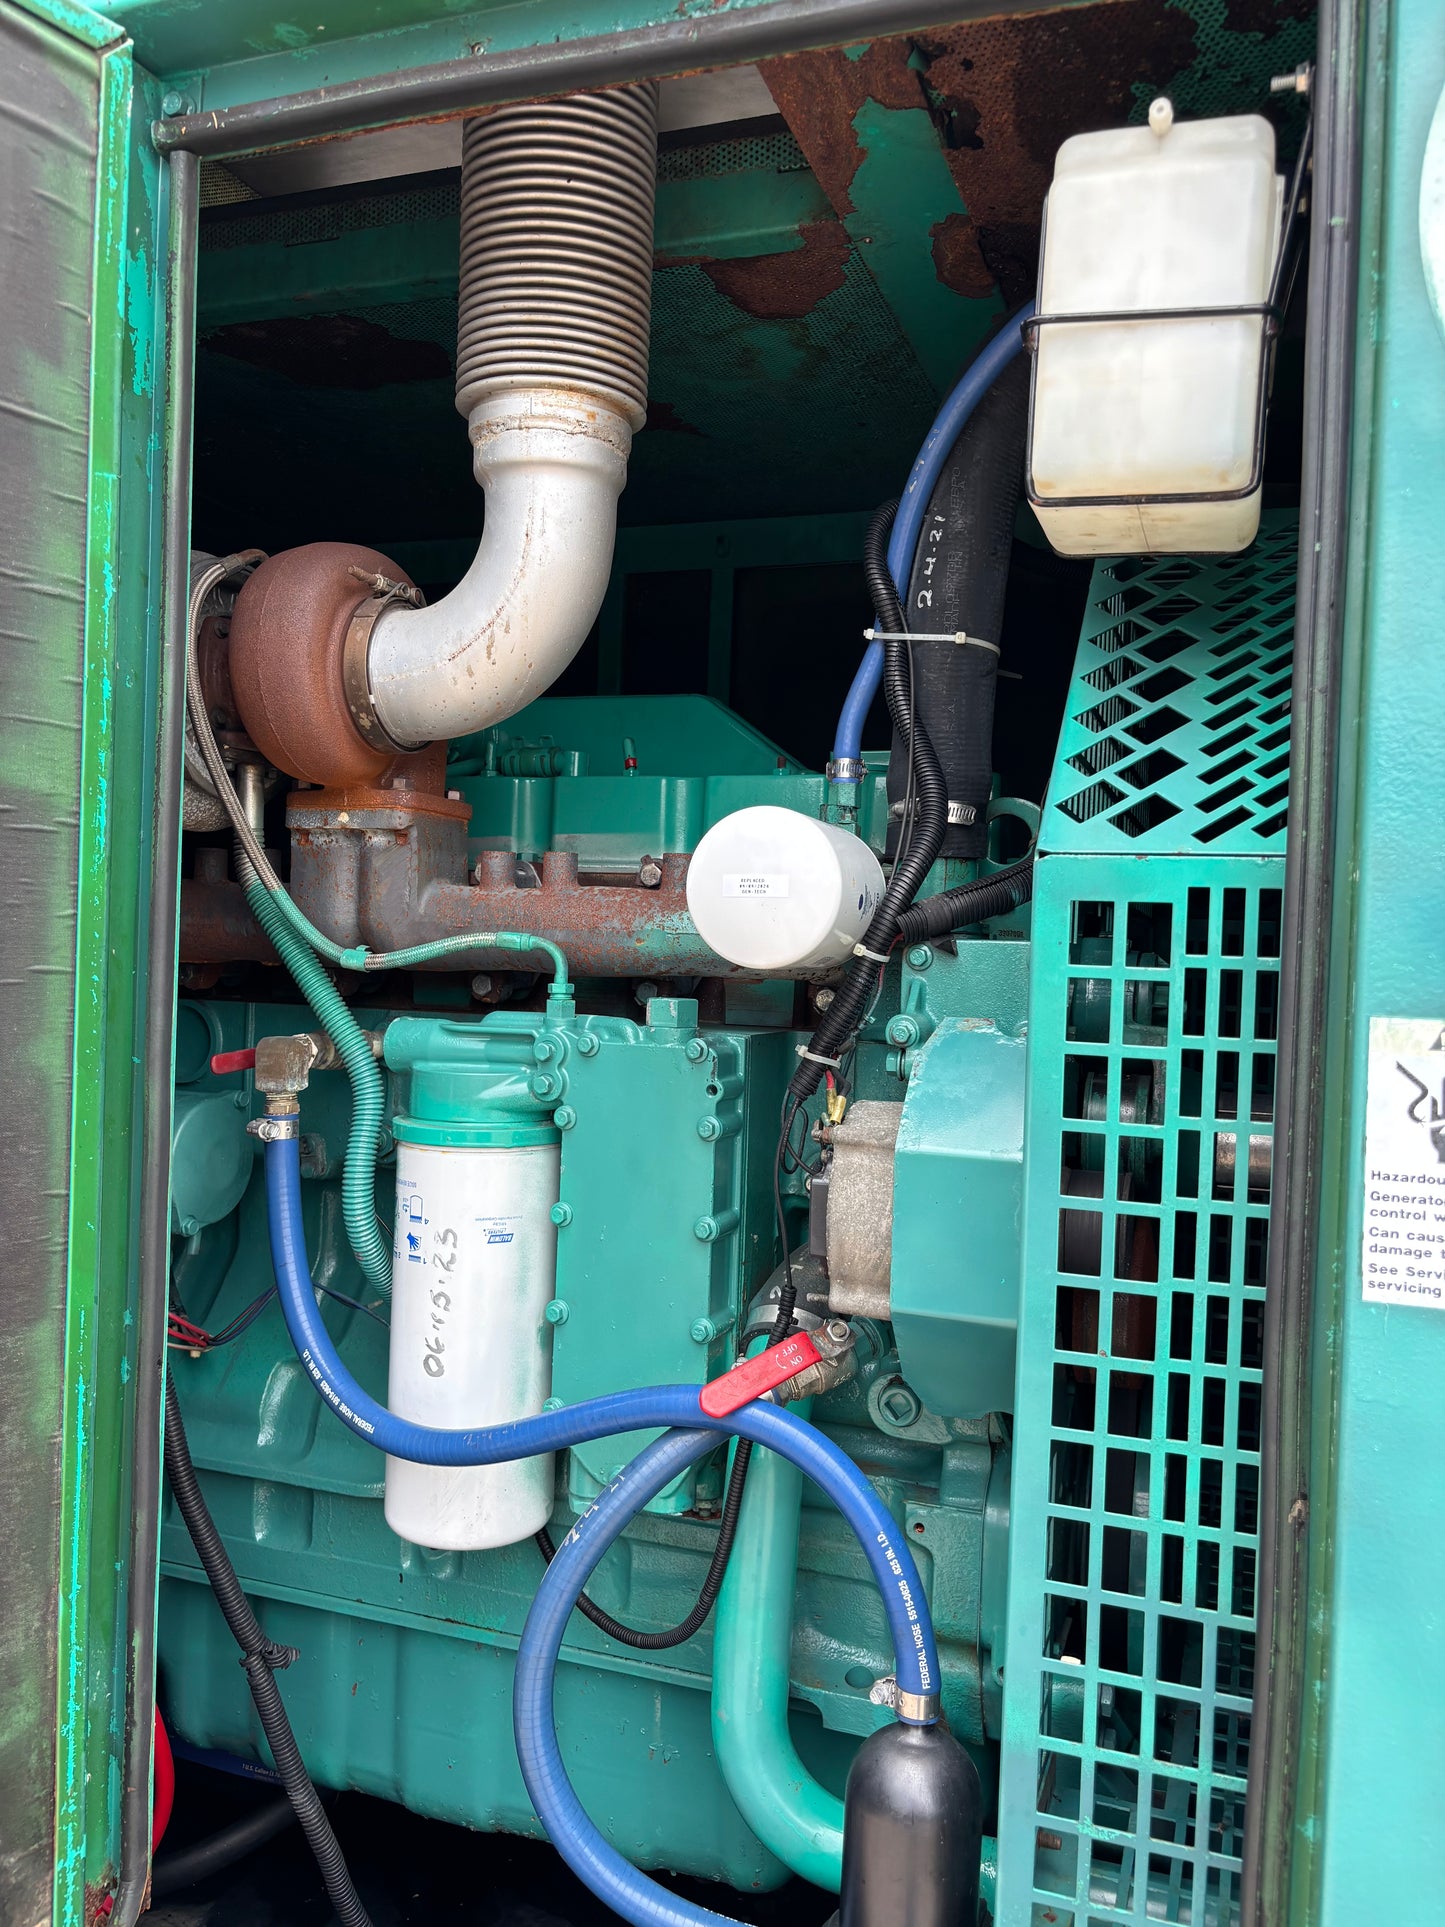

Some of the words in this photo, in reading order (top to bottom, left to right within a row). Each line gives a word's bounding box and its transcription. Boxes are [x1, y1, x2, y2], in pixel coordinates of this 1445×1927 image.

[1370, 1190, 1445, 1206] Generato
[1370, 1208, 1426, 1221] control
[1369, 1226, 1400, 1239] Can
[1369, 1243, 1432, 1259] damage
[1368, 1263, 1398, 1275] See
[1368, 1280, 1442, 1299] servicing
[782, 1343, 798, 1358] OFF
[789, 1355, 803, 1367] ON
[339, 1402, 353, 1420] HOSE
[352, 1413, 375, 1434] FEDERAL
[898, 1579, 918, 1621] 5515-0625
[911, 1623, 924, 1649] HOSE
[916, 1649, 931, 1690] FEDERAL
